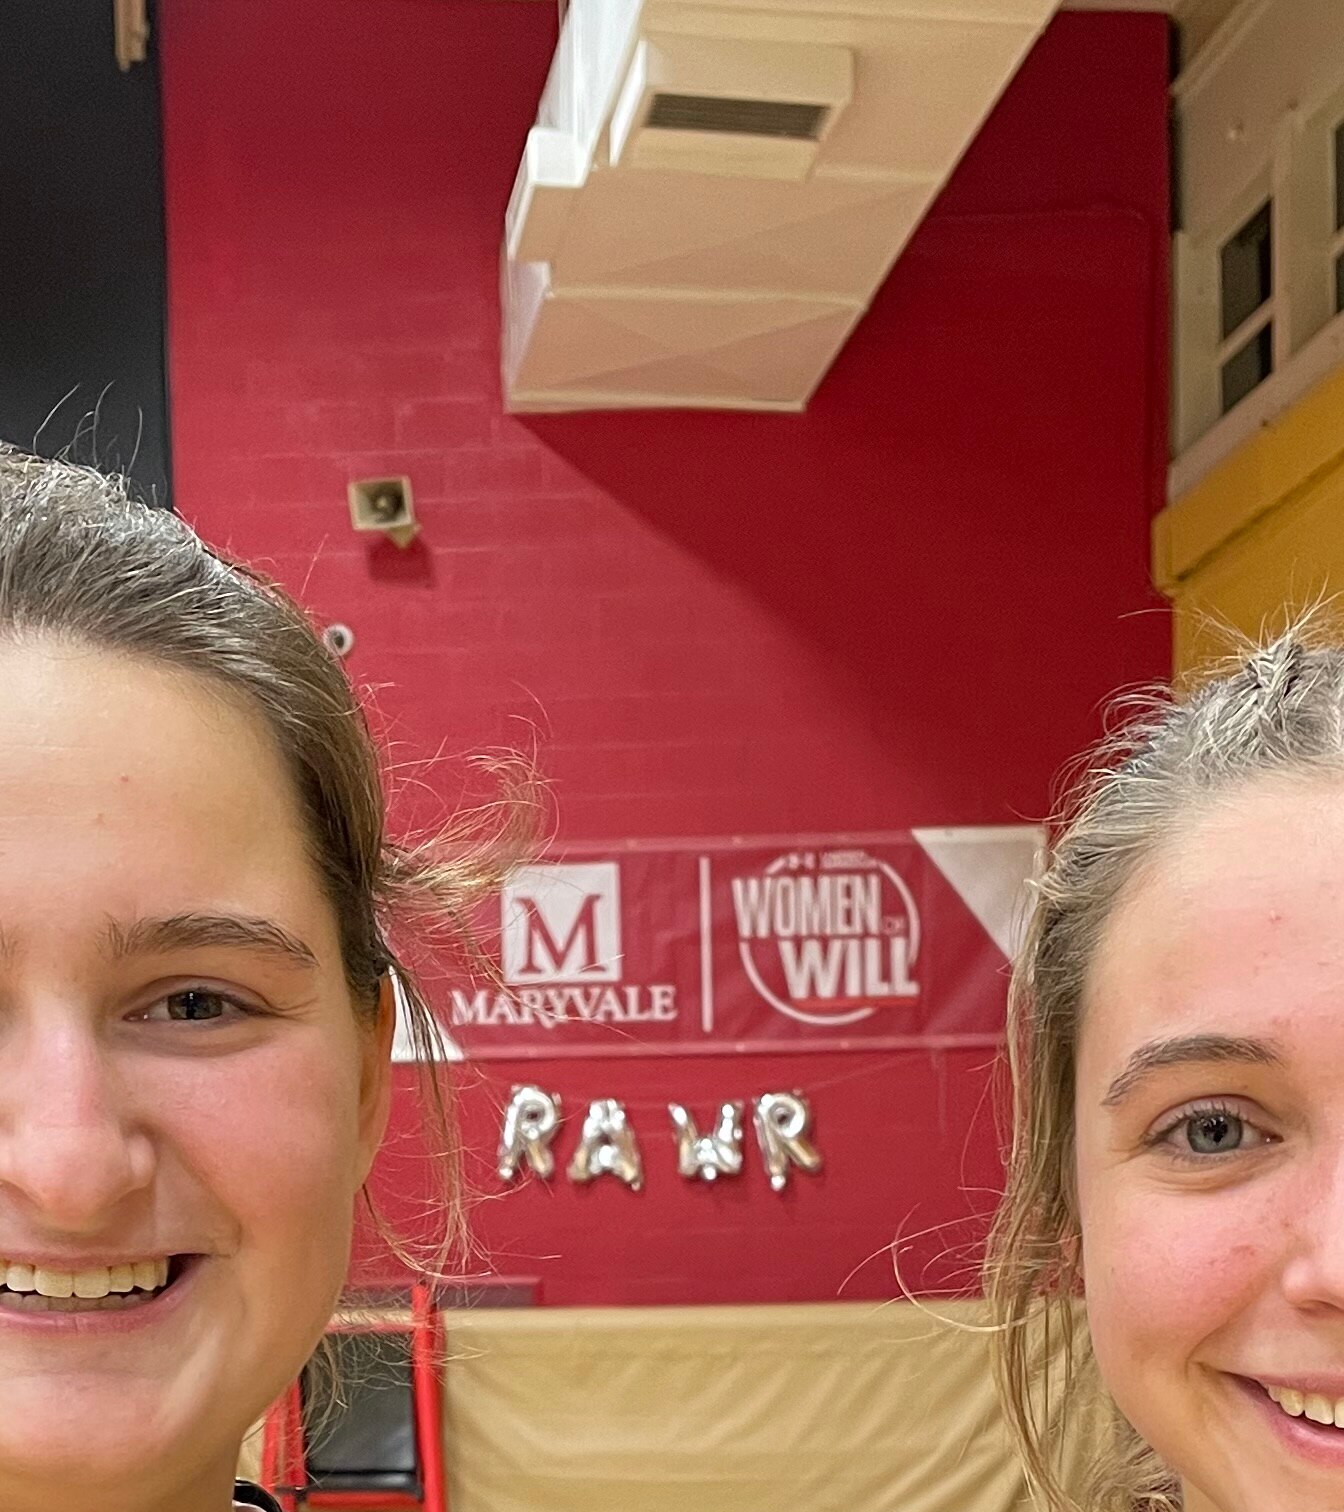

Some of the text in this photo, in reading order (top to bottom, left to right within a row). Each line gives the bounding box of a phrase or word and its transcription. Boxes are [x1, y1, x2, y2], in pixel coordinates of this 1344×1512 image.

[513, 893, 607, 975] M
[732, 873, 883, 939] WOMEN
[778, 936, 921, 999] WILL
[449, 984, 678, 1029] MARYVALE
[498, 1083, 822, 1191] RAWR
